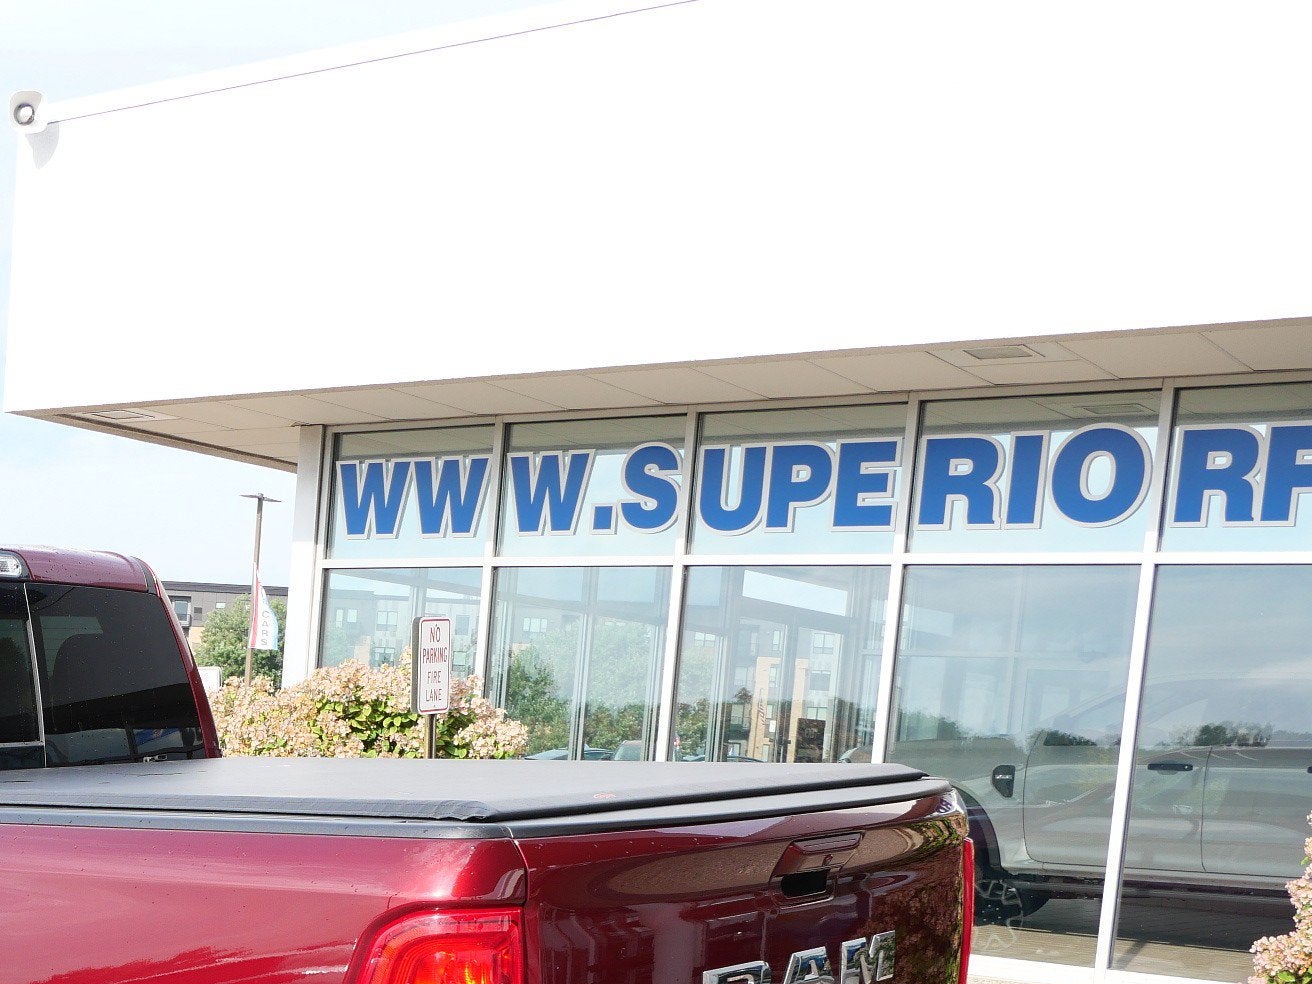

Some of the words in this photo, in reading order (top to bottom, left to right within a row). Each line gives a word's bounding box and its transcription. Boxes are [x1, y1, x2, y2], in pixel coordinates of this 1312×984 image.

[429, 626, 441, 643] NO
[422, 647, 448, 664] PARKING
[427, 670, 442, 685] FIRE
[425, 688, 443, 702] LANE
